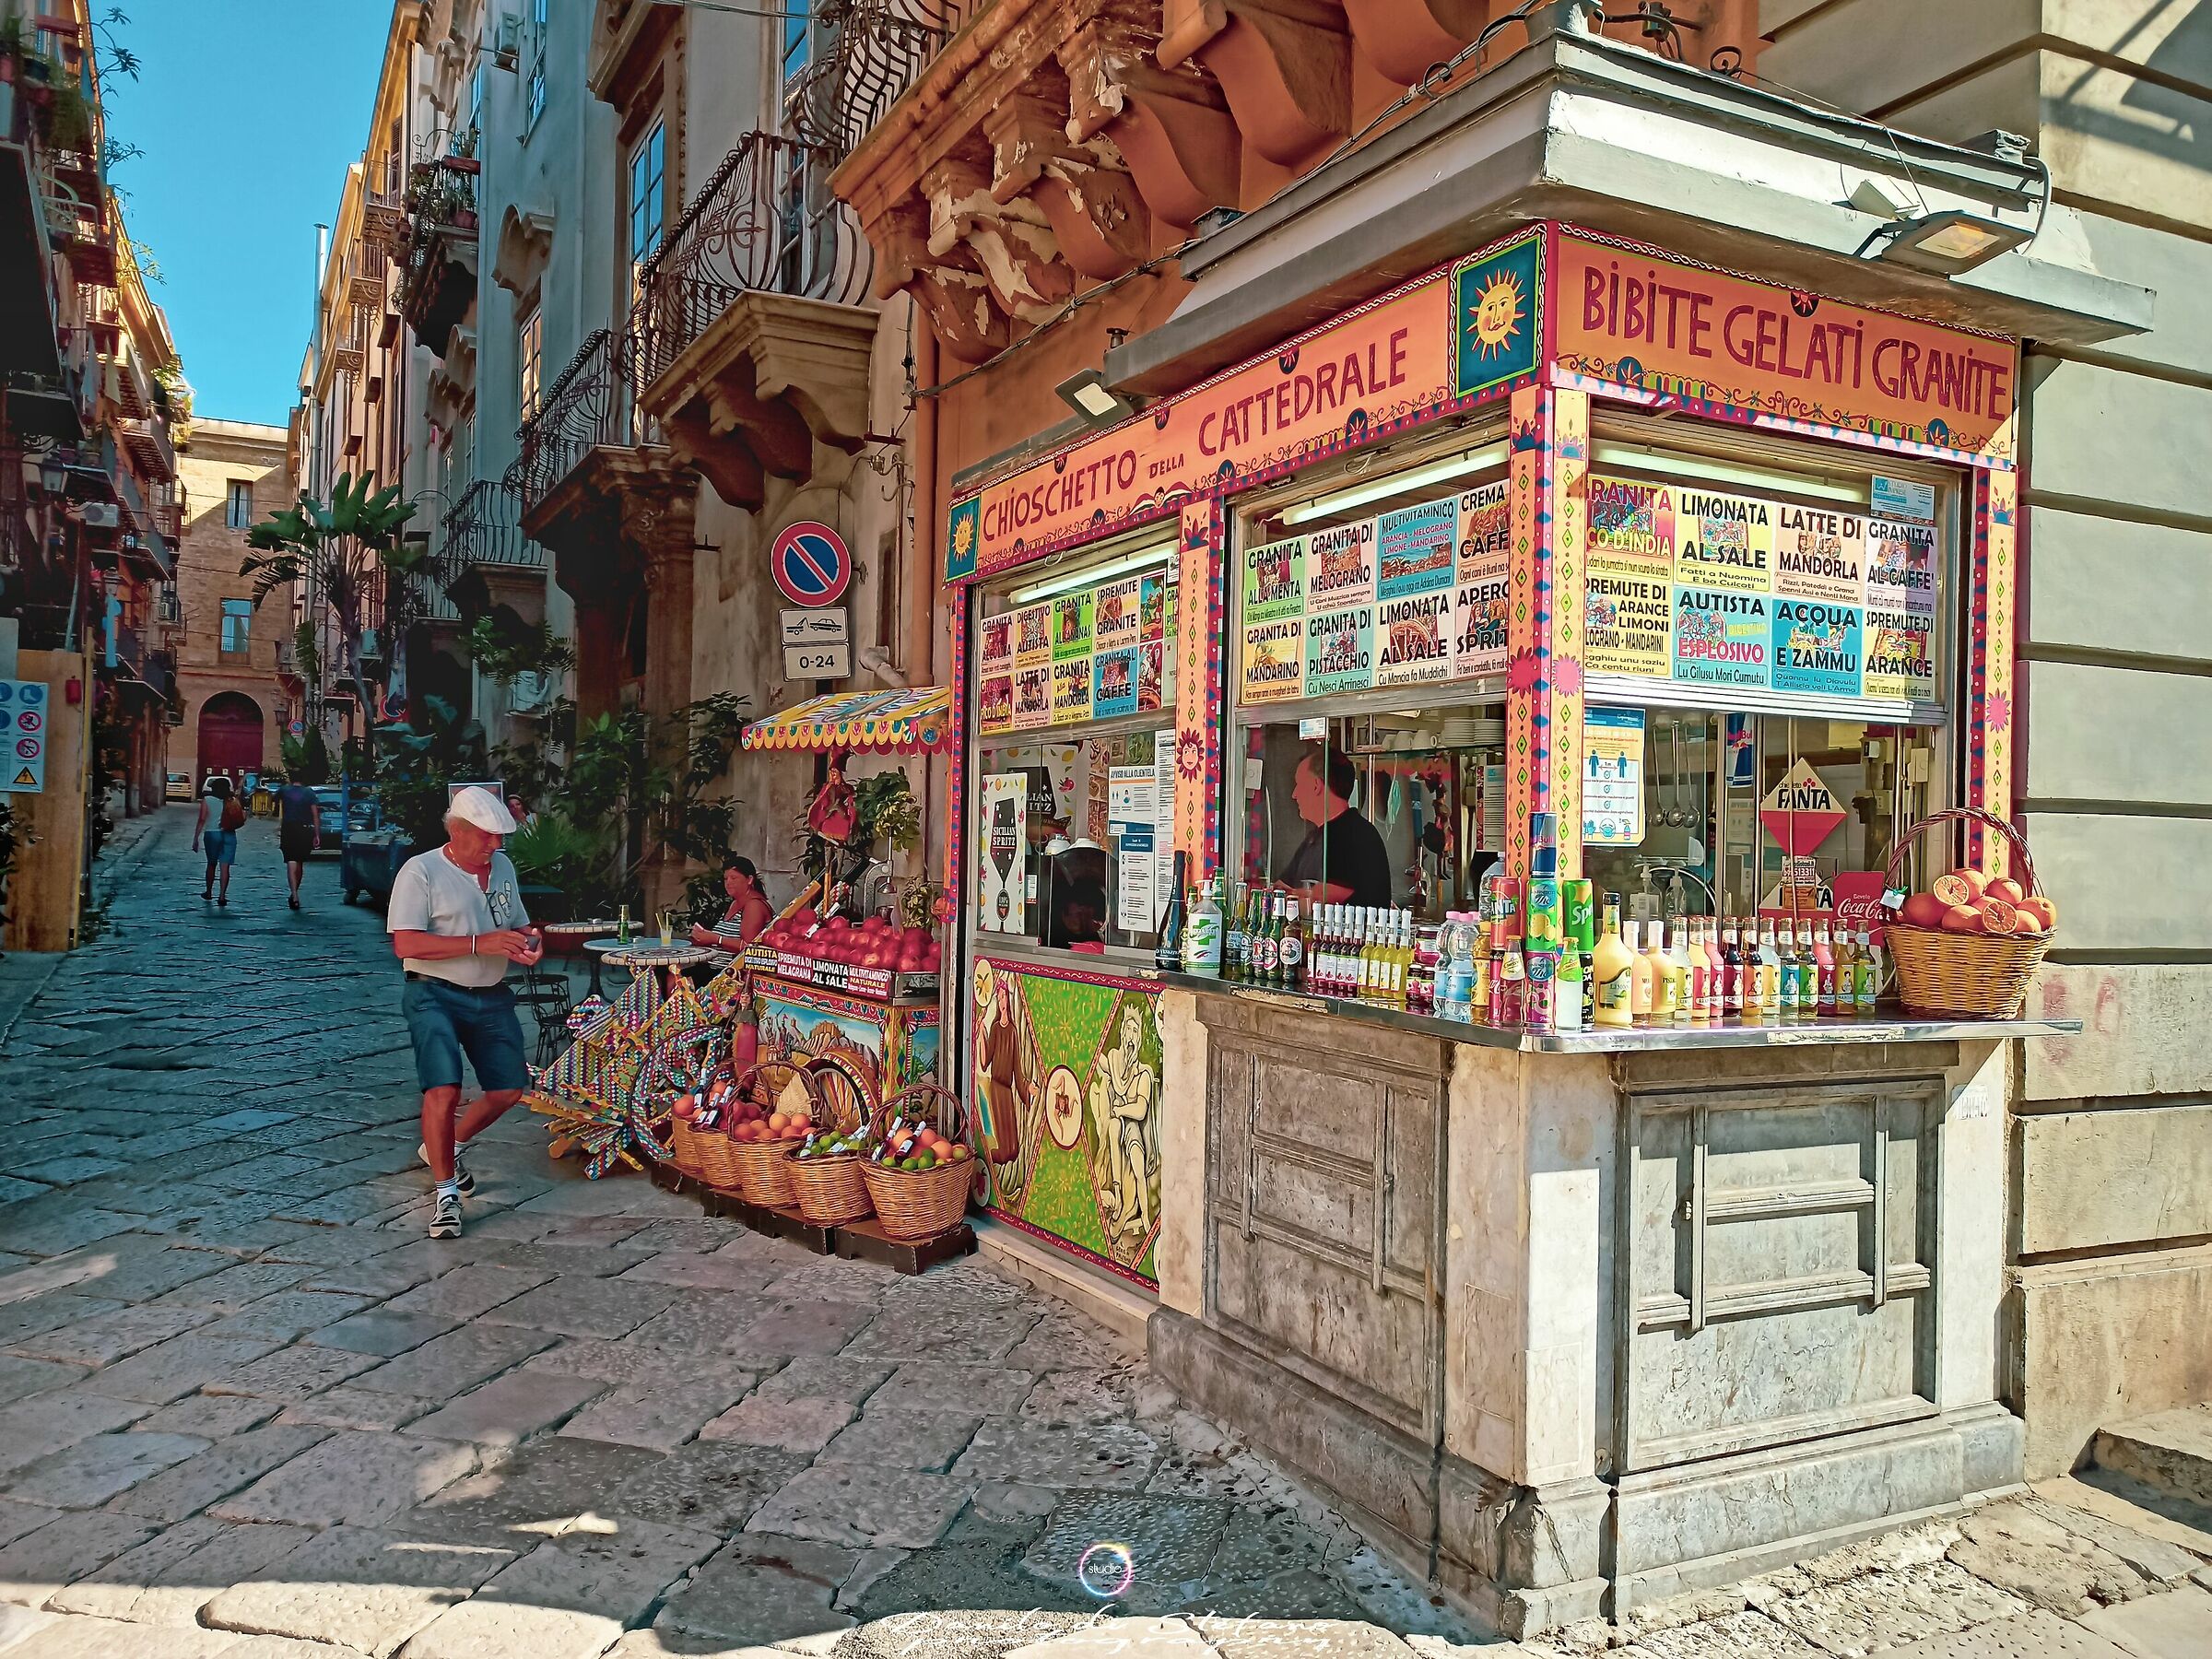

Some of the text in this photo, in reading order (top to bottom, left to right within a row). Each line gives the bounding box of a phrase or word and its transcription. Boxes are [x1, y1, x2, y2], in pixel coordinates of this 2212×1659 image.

[1583, 261, 2009, 421] BIBITE GELATI GRANITE
[1148, 453, 1184, 479] DELLA
[1198, 327, 1409, 455] CATTEDRALE
[1462, 485, 1505, 512] CREMA
[1586, 478, 1673, 512] RANITA
[1382, 500, 1453, 535] MULTIVITAMINICO
[1682, 493, 1768, 525] LIMONATA
[1382, 521, 1453, 545] ARANCIA MELOGRANO
[1781, 507, 1862, 539] LATTE DI
[1868, 522, 1934, 546] GRANITA
[1312, 523, 1373, 556] GRANITA DI
[1384, 544, 1406, 555] LIMONE
[1248, 540, 1302, 569] GRANITA
[1682, 540, 1766, 569] AL SALE
[1680, 567, 1706, 576] Fatti
[1779, 551, 1858, 581] MANDORLA
[1310, 565, 1371, 594] MELOGRANO
[1867, 565, 1935, 590] AL CAFFE'
[1097, 580, 1137, 602] SPREMUTE
[1248, 580, 1301, 606] ALLA MENTA
[1652, 584, 1666, 600] DI
[1054, 593, 1091, 613] GRANITA
[1380, 594, 1449, 626] LIMONATA
[1619, 600, 1669, 617] ARANCE
[1678, 591, 1765, 616] AUTISTA
[982, 616, 1012, 632] GRANITA
[1017, 606, 1051, 623] DIGESTIVO
[1097, 613, 1136, 635] GRANITE
[1309, 611, 1357, 637] GRANITA
[1359, 609, 1371, 629] DI
[1619, 617, 1669, 632] LIMONI
[1777, 602, 1857, 628] ACQUA
[1866, 610, 1934, 633] SPREMUTE DI
[1247, 621, 1301, 644] GRANITA DI
[1626, 632, 1664, 653] MANDARINI
[1017, 636, 1049, 653] AUTISTA
[1380, 638, 1448, 665] AL SALE
[1677, 638, 1764, 664] ESPLOSIVO
[799, 655, 835, 669] 0-24
[1053, 659, 1090, 680] GRANITA
[1309, 651, 1370, 676] PISTACCHIO
[1776, 647, 1855, 672] E ZAMMU
[1865, 654, 1933, 677] ARANCE
[1016, 667, 1050, 687] LATTE DI
[1246, 661, 1300, 684] MANDARINO
[1379, 674, 1387, 685] Cu
[1410, 669, 1418, 680] fa
[1677, 665, 1688, 677] Lu
[1715, 667, 1733, 681] Mori
[1096, 682, 1135, 701] CAFFE'
[1309, 682, 1317, 694] Cu
[1319, 679, 1337, 692] Nesci
[1015, 698, 1049, 713] MANDORLA
[1053, 692, 1089, 709] MANDORLA
[1777, 785, 1831, 810] FANTA
[993, 826, 1017, 836] SICILIAN
[993, 836, 1016, 846] SPRITZ
[745, 947, 778, 959] AUTISTA
[778, 952, 811, 968] SPREMUTA DI
[745, 964, 776, 972] NATURALE
[777, 964, 811, 980] MELAGRANA
[812, 959, 849, 976] LIMONATA
[812, 972, 848, 989] AL SALE
[850, 977, 886, 989] NATURALE
